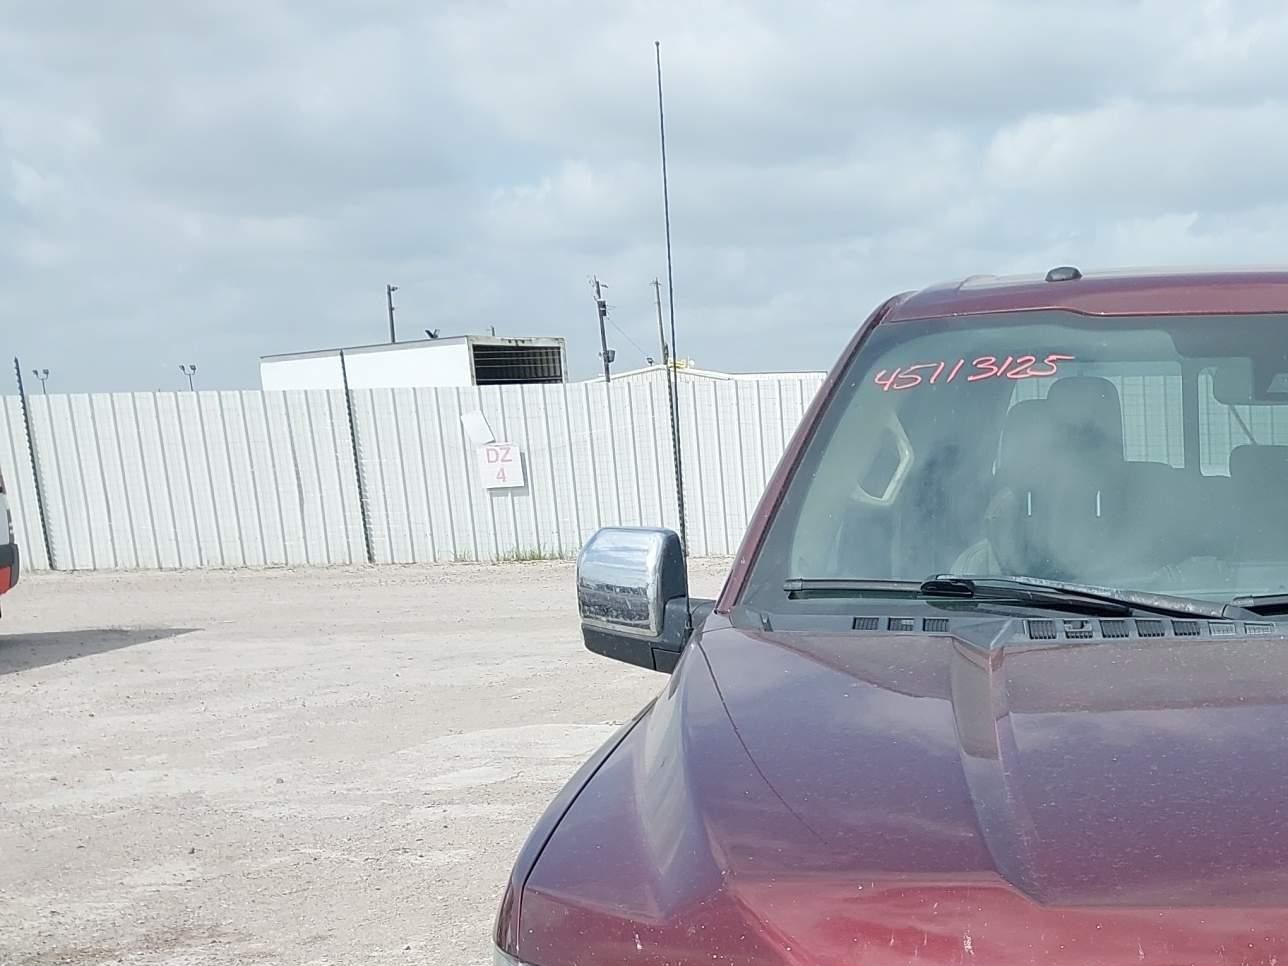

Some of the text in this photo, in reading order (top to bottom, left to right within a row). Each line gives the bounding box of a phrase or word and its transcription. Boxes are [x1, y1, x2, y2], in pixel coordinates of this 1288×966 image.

[874, 354, 1075, 392] 45113125
[485, 447, 513, 464] DZ
[495, 467, 507, 483] 4
